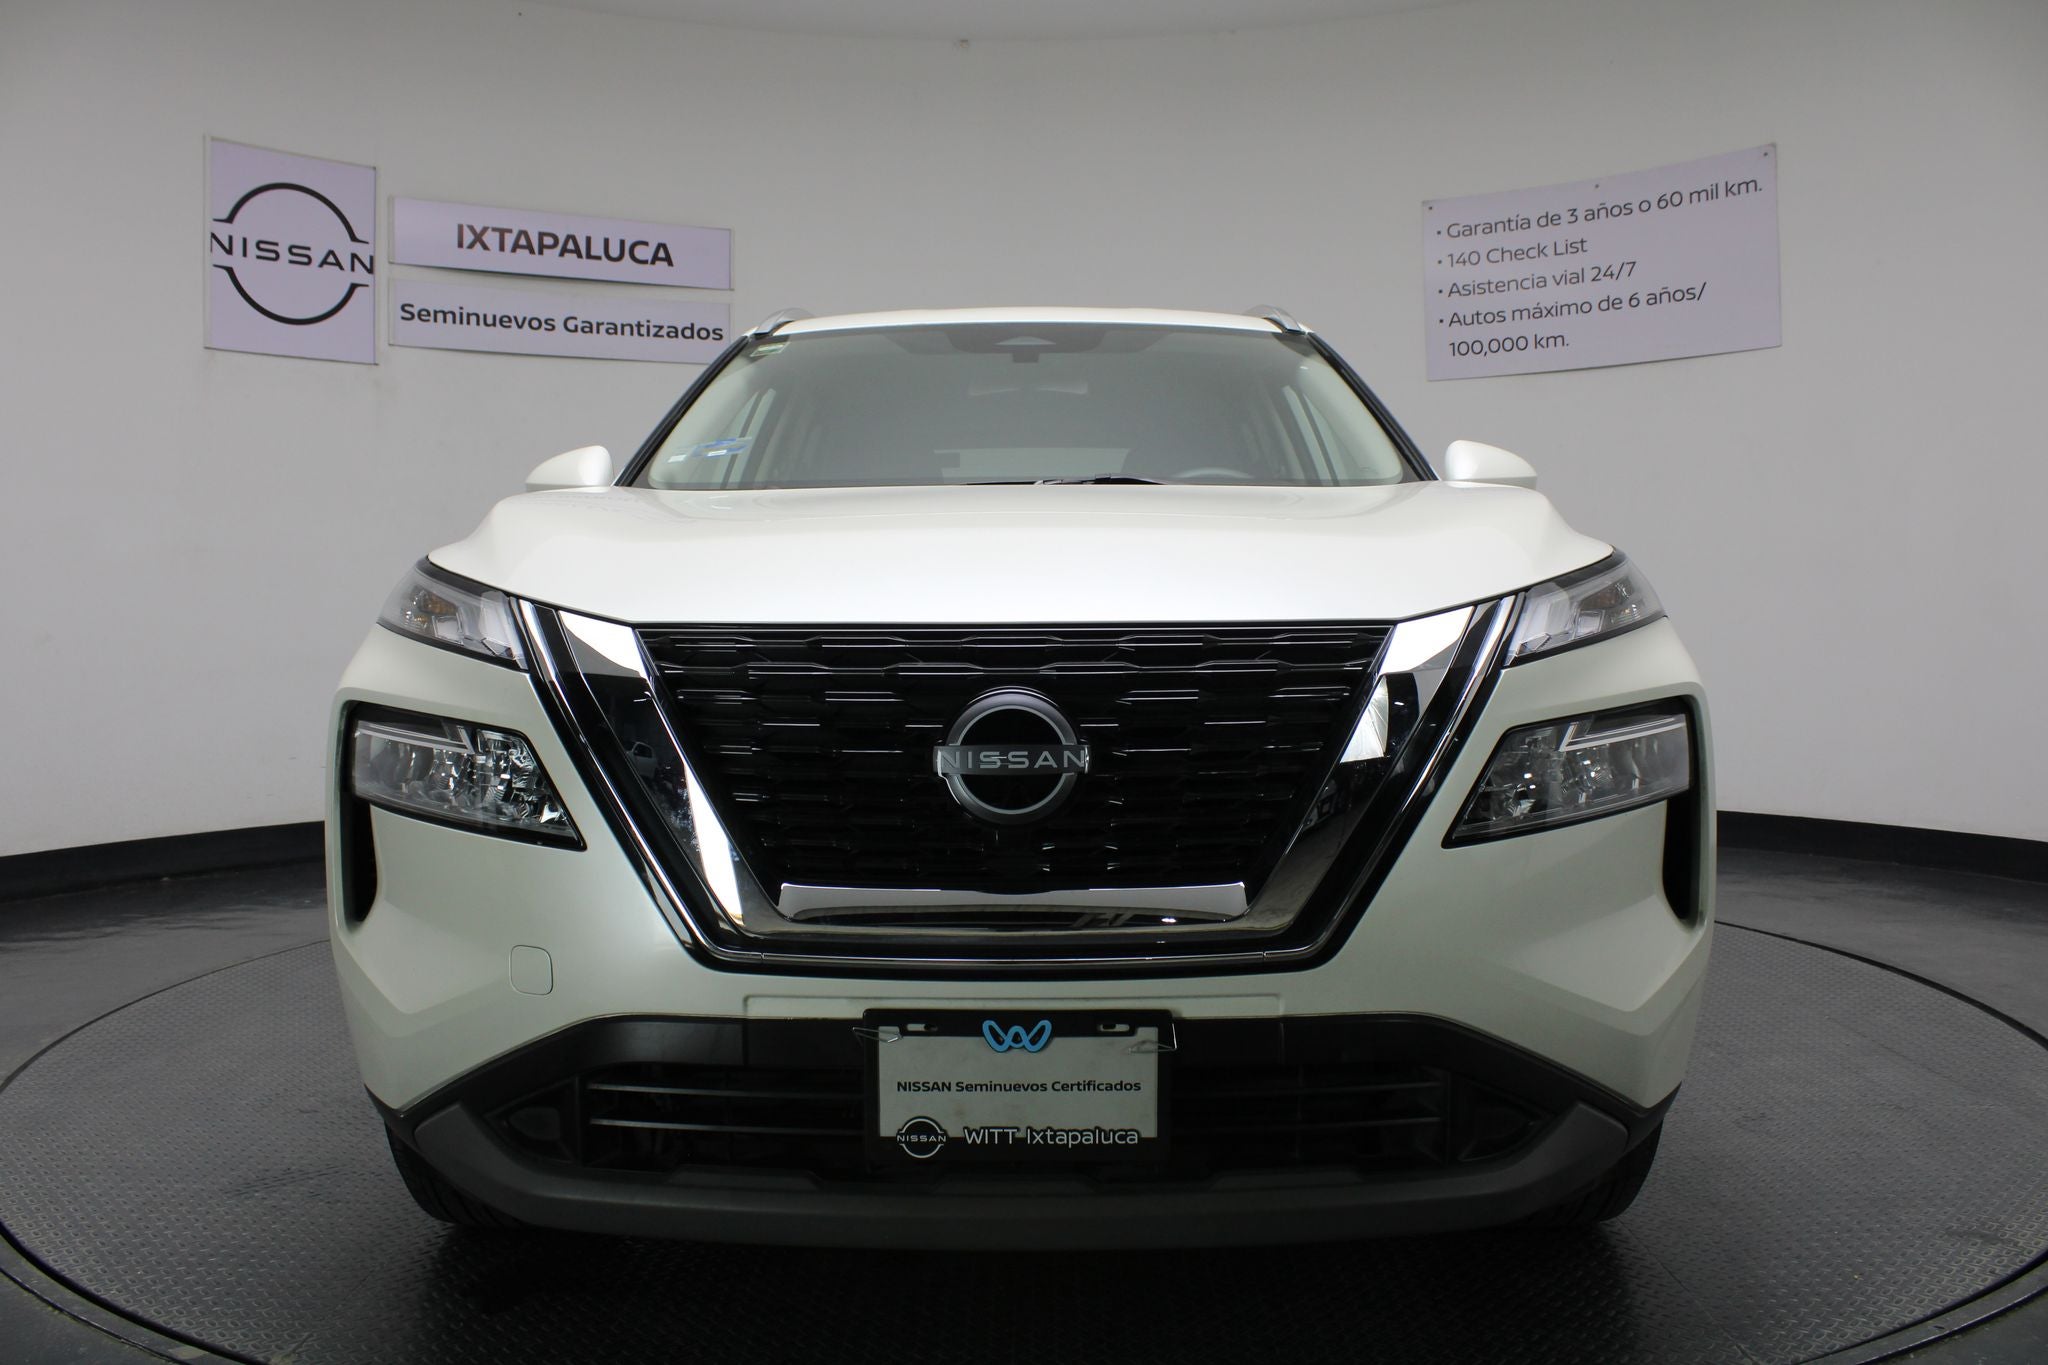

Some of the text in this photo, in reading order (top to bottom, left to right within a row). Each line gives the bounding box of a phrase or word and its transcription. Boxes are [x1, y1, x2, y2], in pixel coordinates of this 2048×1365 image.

[1447, 177, 1762, 239] Garantía de 3 años o 60 mil km.
[210, 231, 374, 274] NISSAN
[456, 223, 674, 267] IXTAPALUCA
[1448, 238, 1588, 268] 140 Check List
[1448, 261, 1636, 298] Asistencia vial 24/7
[1449, 282, 1707, 328] Autos máximo de 6 años/
[400, 303, 724, 342] Seminuevos Garantizados
[1448, 334, 1569, 357] 100,000 km.
[938, 751, 1085, 769] NISSAN
[897, 1080, 1141, 1092] NISSAN Seminuevos Certificados
[897, 1134, 946, 1142] NISSAN
[964, 1127, 1138, 1148] WITT Ixtapaluca
